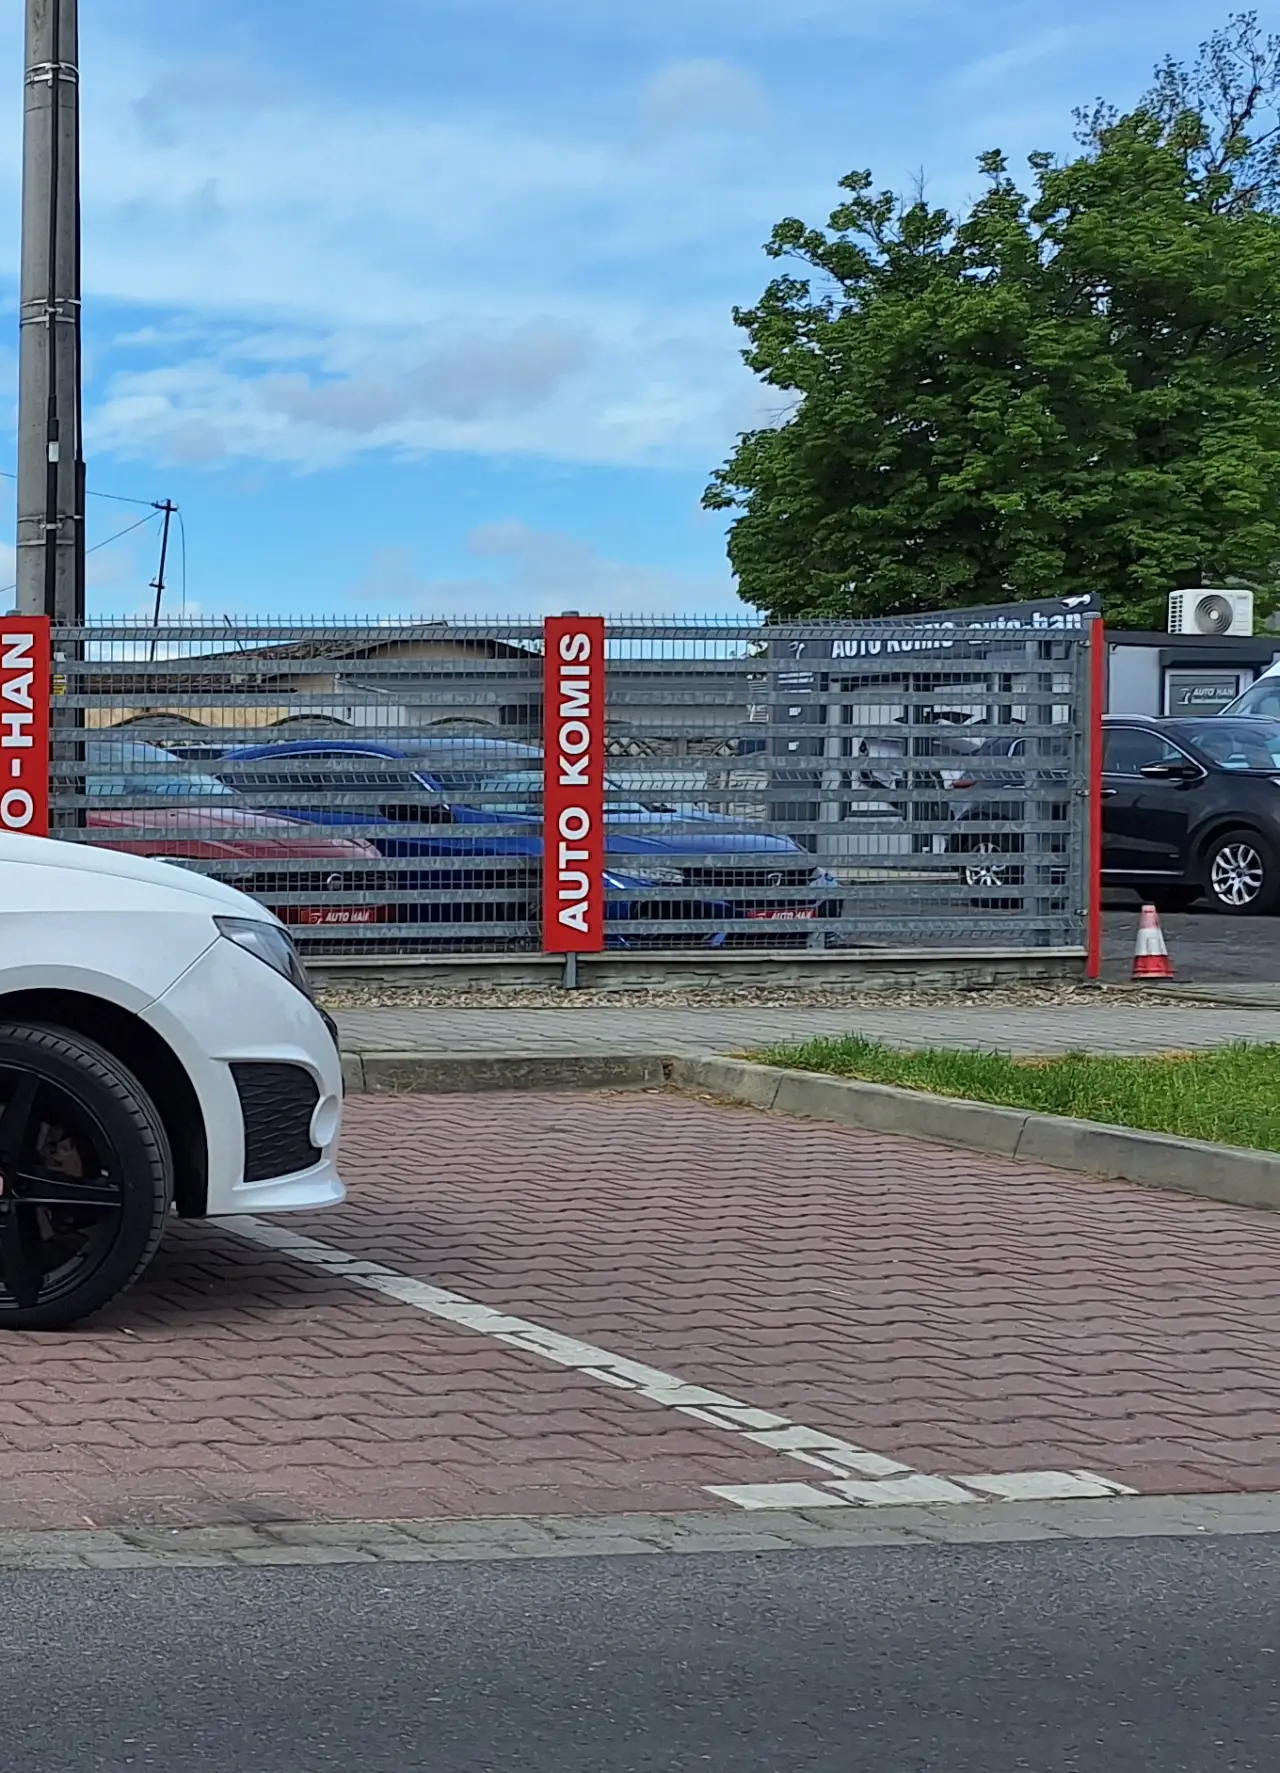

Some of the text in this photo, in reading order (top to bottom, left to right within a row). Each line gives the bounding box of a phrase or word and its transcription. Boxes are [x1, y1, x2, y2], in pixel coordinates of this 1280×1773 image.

[0, 633, 34, 828] O-HAN
[558, 632, 591, 933] AUTO KOMIS
